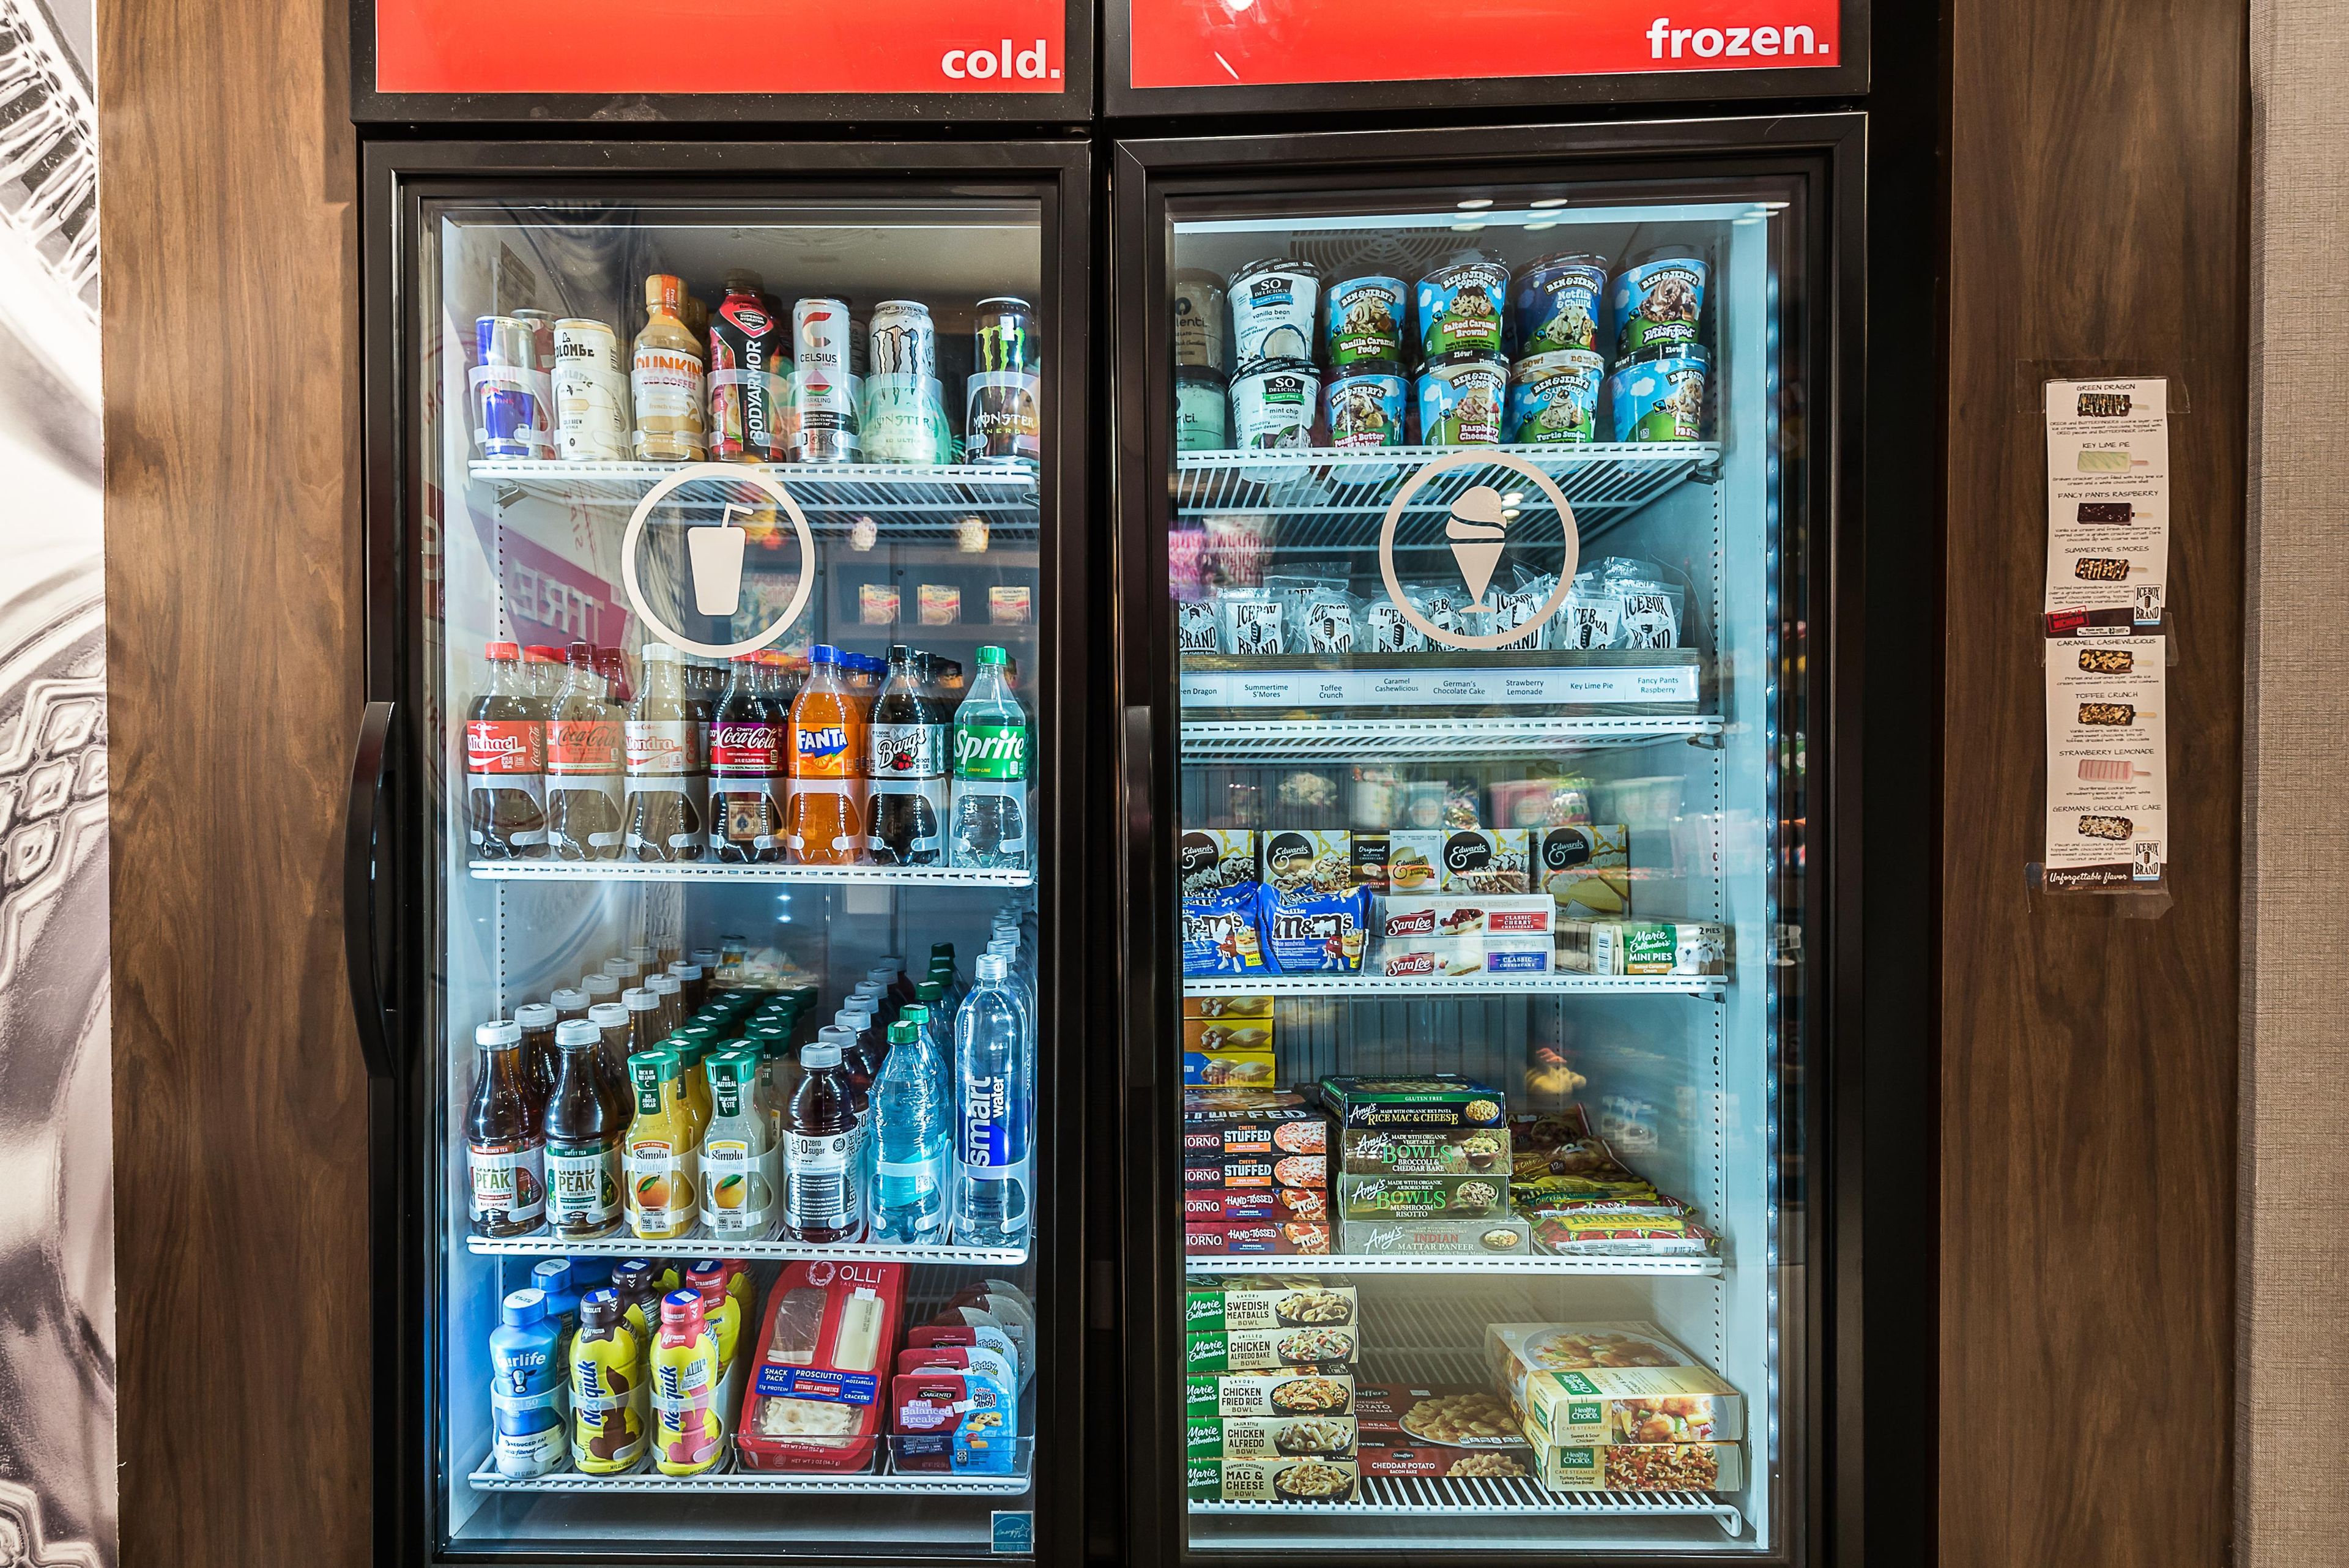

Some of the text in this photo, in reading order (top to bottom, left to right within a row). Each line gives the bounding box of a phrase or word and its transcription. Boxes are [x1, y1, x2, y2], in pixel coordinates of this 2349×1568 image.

[1646, 18, 1829, 58] frozen.
[941, 39, 1062, 79] cold.
[1261, 280, 1281, 290] SO
[1255, 288, 1288, 297] DELICIOUS
[1442, 320, 1496, 332] Salted Caramel
[563, 332, 571, 343] La
[1456, 328, 1488, 338] Brownie
[1340, 338, 1395, 350] Vanilla Caramel
[1357, 346, 1380, 354] Fudge
[800, 354, 837, 362] CELSIUS
[1275, 378, 1295, 387] SO
[746, 340, 762, 442] BODYARMOR
[973, 412, 1033, 428] MONSTER
[2136, 607, 2159, 620] BRAND
[468, 735, 518, 751] Michael
[720, 727, 777, 749] Coca-Cola
[798, 728, 848, 749] FANTA
[877, 729, 926, 768] Barq's
[955, 729, 1024, 765] Sprite
[2135, 862, 2158, 874] BRAND
[2050, 872, 2128, 885] Unforgettable flavor
[1630, 931, 1667, 943] Marie
[990, 1076, 1004, 1118] water
[1349, 1104, 1377, 1123] Amy's
[1368, 1114, 1390, 1125] RICE
[1420, 1114, 1458, 1124] CHEESE
[970, 1076, 990, 1166] smart
[1225, 1131, 1271, 1142] STUFFED
[801, 1139, 807, 1153] 0
[809, 1147, 825, 1156] sugar
[1382, 1145, 1453, 1163] BOWLS
[1225, 1164, 1271, 1176] STUFFED
[559, 1175, 595, 1192] PEAK
[1352, 1179, 1386, 1203] Amy's
[1225, 1194, 1274, 1205] HAND-TOSSED
[1376, 1191, 1445, 1209] BOWLS
[1364, 1227, 1403, 1254] Amy's
[1414, 1234, 1458, 1243] INDIAN
[840, 1265, 882, 1283] OLLI
[1189, 1300, 1220, 1312] Marie
[1227, 1302, 1269, 1311] SWEDISH
[1192, 1341, 1223, 1351] Marie
[1231, 1342, 1270, 1352] CHICKEN
[796, 1370, 842, 1380] PROSCIUTTO
[581, 1360, 605, 1427] Nesquik
[1223, 1388, 1261, 1396] CHICKEN
[660, 1365, 679, 1432] Nesquik
[1222, 1397, 1245, 1406] FRIED
[1228, 1430, 1264, 1438] CHICKEN
[1228, 1439, 1264, 1447] ALFREDO
[1226, 1471, 1252, 1480] MAC
[1226, 1481, 1264, 1490] CHEESE
